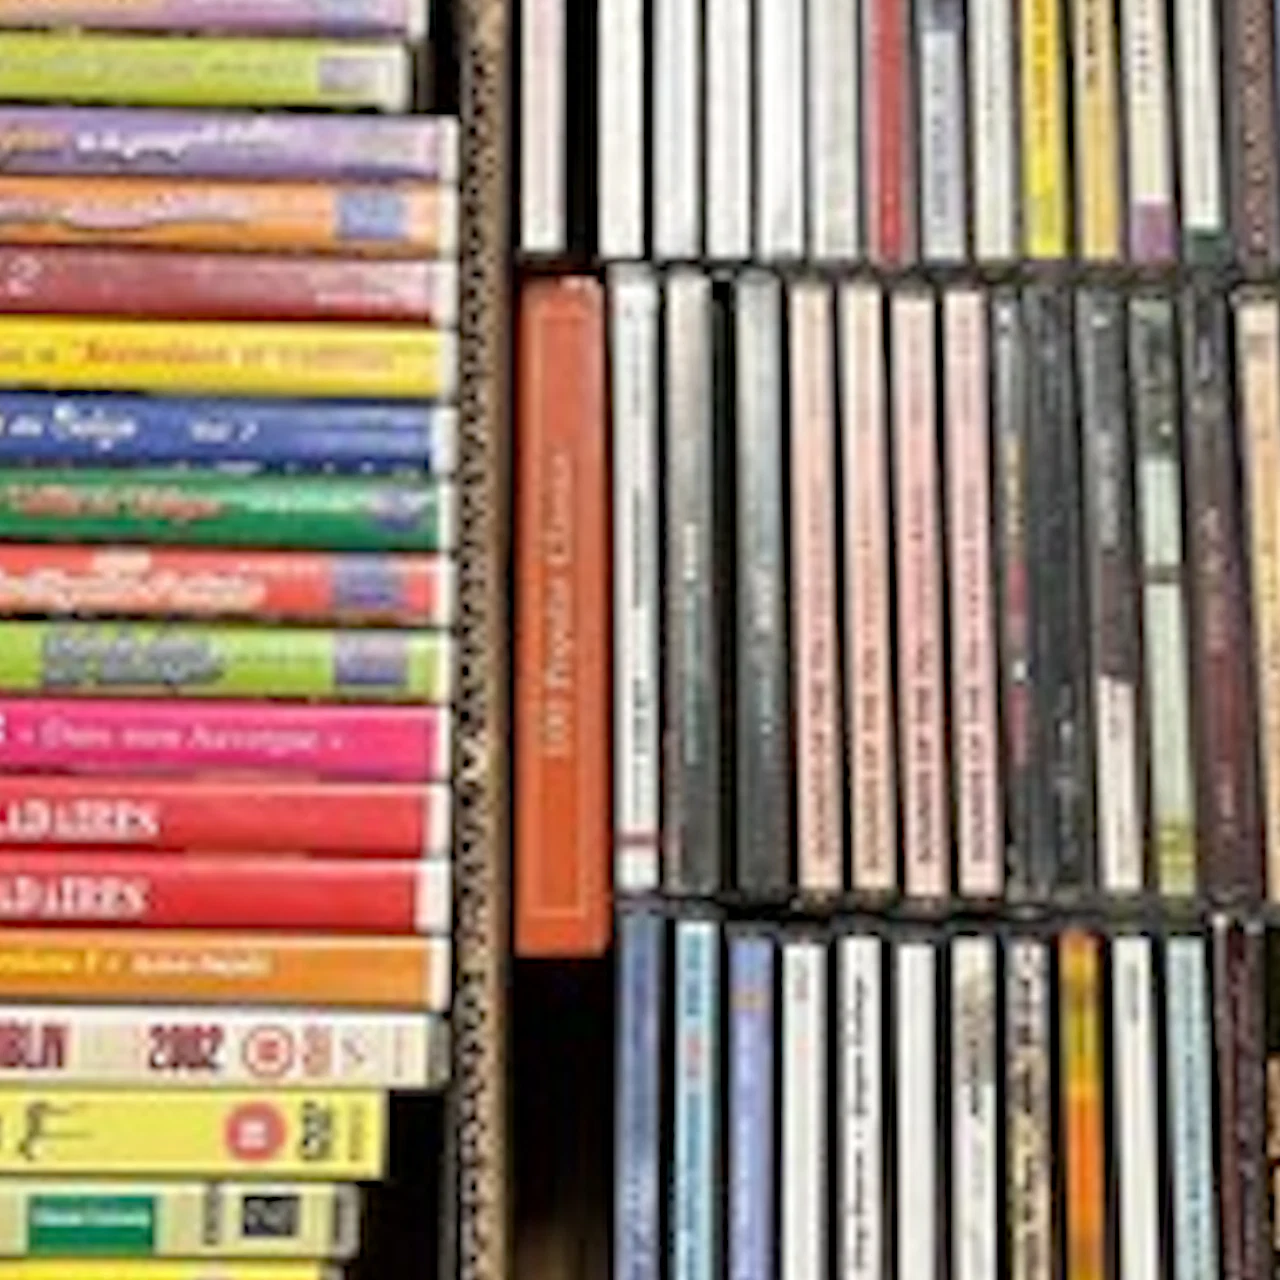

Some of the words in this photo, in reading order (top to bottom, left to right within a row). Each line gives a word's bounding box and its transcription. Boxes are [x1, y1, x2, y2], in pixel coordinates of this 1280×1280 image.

[540, 453, 571, 567] Classics
[541, 578, 575, 691] Popular
[541, 700, 571, 758] 100
[859, 692, 879, 734] THE
[911, 683, 932, 727] THE
[964, 683, 985, 724] THE
[911, 731, 933, 764] OF
[965, 731, 986, 763] OF
[860, 776, 881, 871] SOUNDS
[912, 769, 934, 866] SOUNDS
[966, 770, 988, 865] SOUNDS
[147, 1025, 226, 1070] 2002
